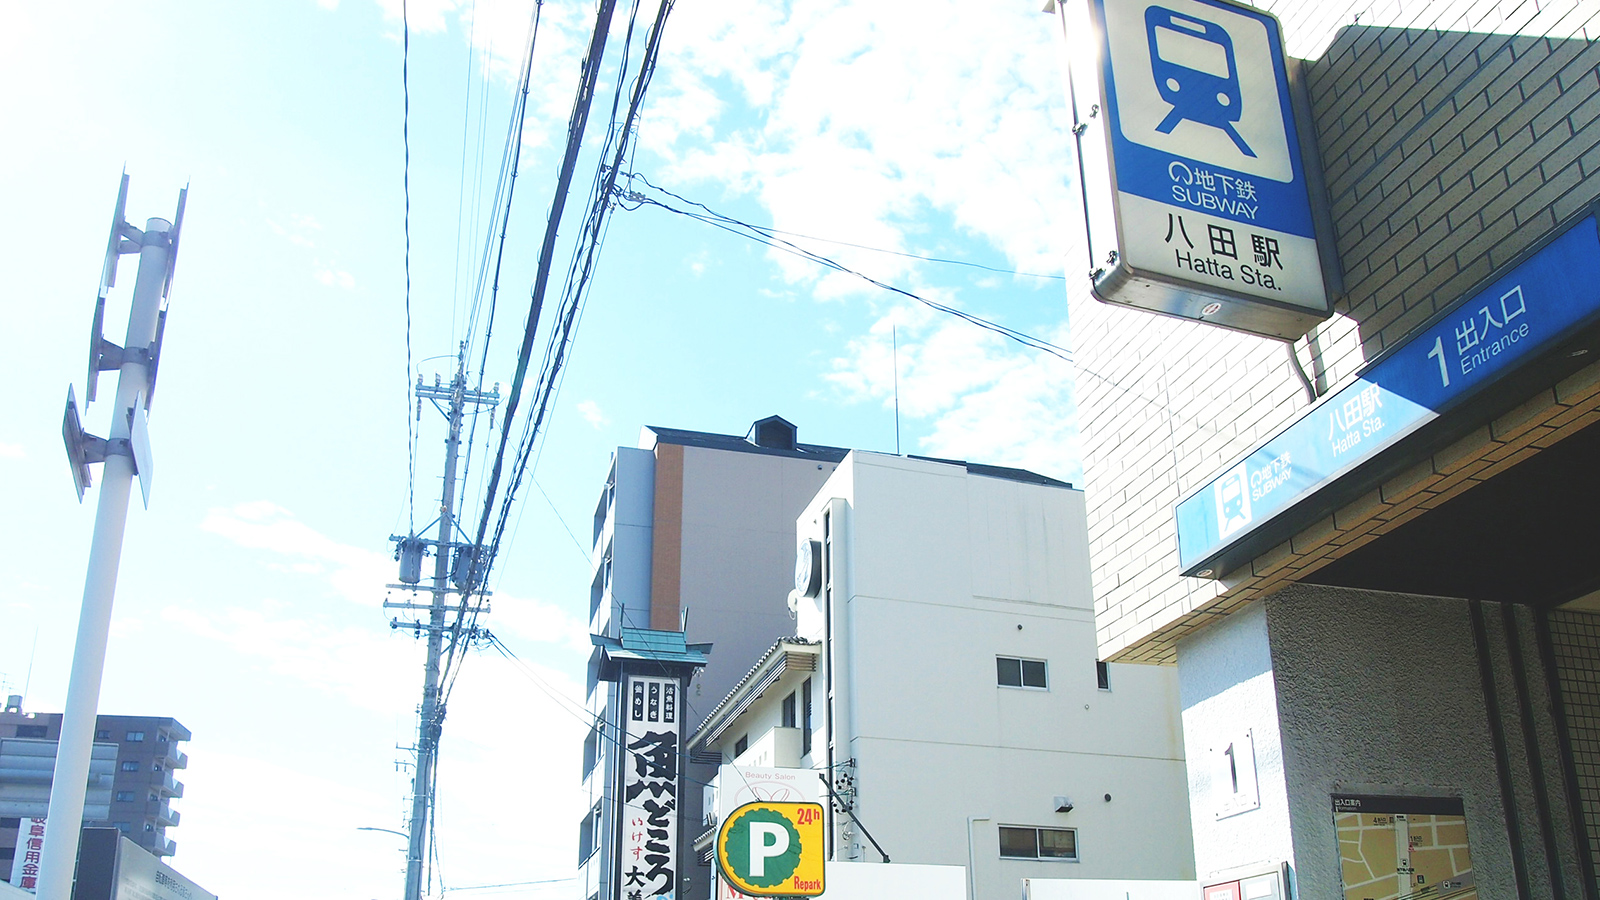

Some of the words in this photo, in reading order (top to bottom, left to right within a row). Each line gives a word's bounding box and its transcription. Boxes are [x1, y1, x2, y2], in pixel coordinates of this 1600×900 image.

[1172, 185, 1258, 220] SUBWAY
[1194, 167, 1258, 202] 地下鉄
[1164, 213, 1284, 271] 八田駅
[1175, 249, 1235, 281] Hatta
[1240, 266, 1282, 291] Sta.
[1455, 284, 1527, 356] 出入口
[1427, 336, 1450, 388] 1
[1460, 323, 1530, 376] Entrance
[1328, 382, 1383, 441] 八田駅
[1332, 429, 1361, 458] Hatta
[1363, 416, 1386, 438] Sta.
[1251, 467, 1292, 501] SUBWAY
[1261, 451, 1292, 481] 地下鉄
[649, 685, 658, 719] うなぎ
[745, 771, 772, 780] Beauty
[774, 772, 796, 780] Salon
[1224, 742, 1238, 793] 1
[626, 730, 677, 898] 魚どころ
[797, 808, 820, 825] 24h
[630, 817, 644, 861] いけす
[749, 821, 790, 877] P
[794, 876, 821, 891] Repark
